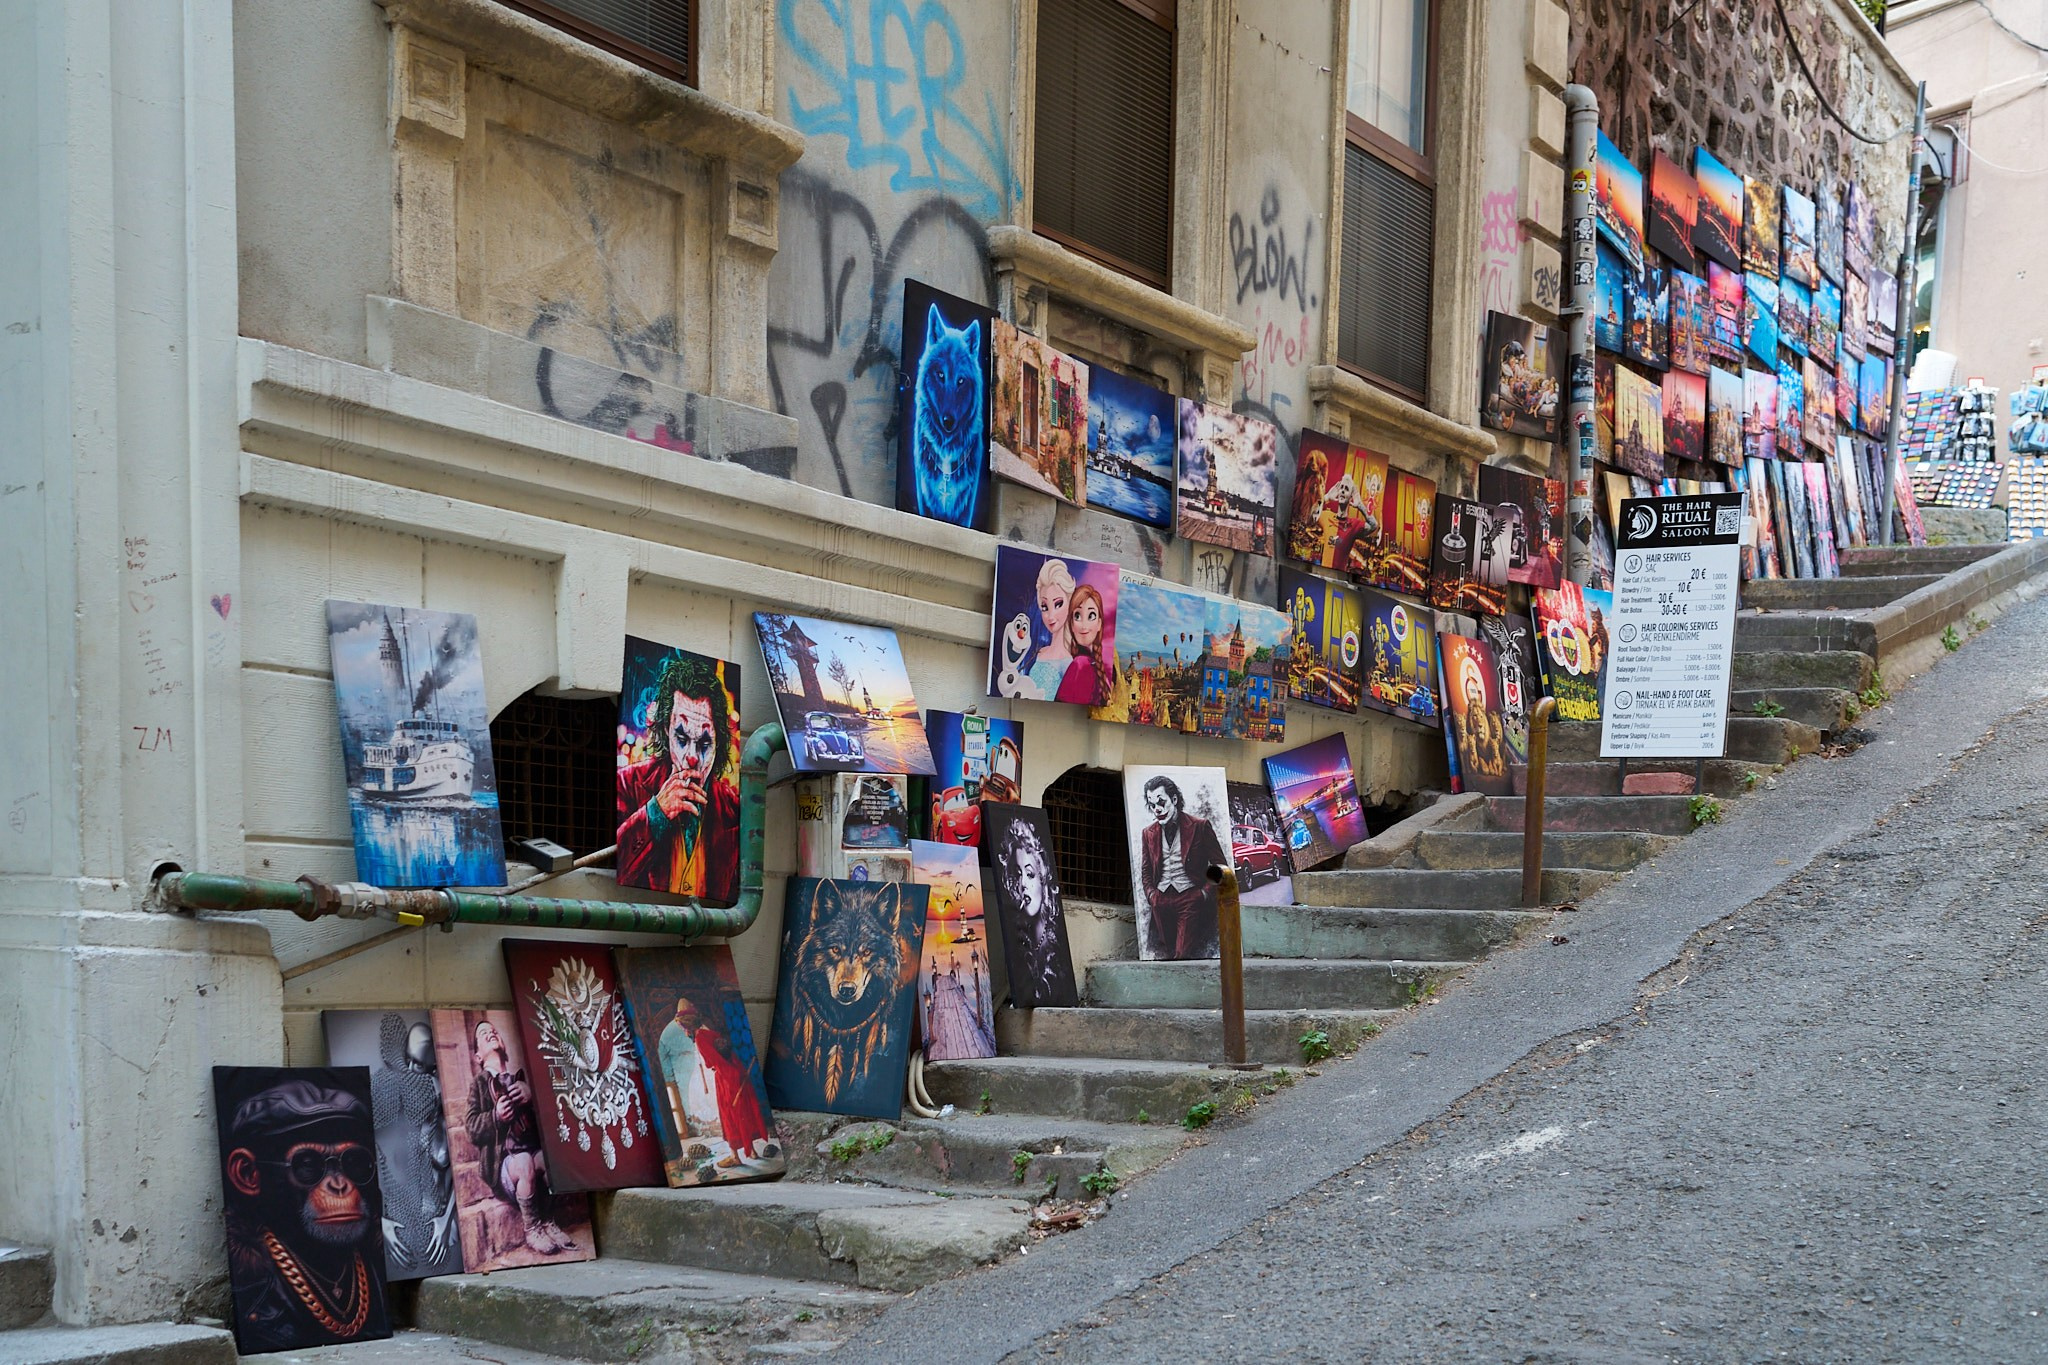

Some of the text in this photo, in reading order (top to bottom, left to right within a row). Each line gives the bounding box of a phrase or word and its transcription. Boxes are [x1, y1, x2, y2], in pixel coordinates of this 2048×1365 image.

[1662, 503, 1683, 512] THE
[1686, 501, 1712, 510] HAIR
[1661, 511, 1711, 524] RITUAL
[1661, 527, 1710, 538] SALOON
[1646, 552, 1692, 563] HAIR SERVICES
[1645, 563, 1657, 573] SAÇ
[1691, 568, 1700, 580] 20
[1701, 568, 1707, 580] €
[1621, 587, 1640, 595] Blowdry
[1678, 582, 1686, 593] 10
[1686, 581, 1692, 593] €
[1658, 593, 1667, 604] 30
[1669, 592, 1674, 603] €
[1661, 605, 1681, 616] 30-50
[1682, 604, 1688, 615] €
[1641, 621, 1719, 632] HAIR COLORING SERVICES
[1641, 633, 1653, 643] SAÇ
[1636, 690, 1711, 700] NAIL-HAND & FOOT CARE
[1636, 699, 1715, 709] TIRNAK EL VE AYAK BAKIMI
[966, 720, 983, 733] ROMA
